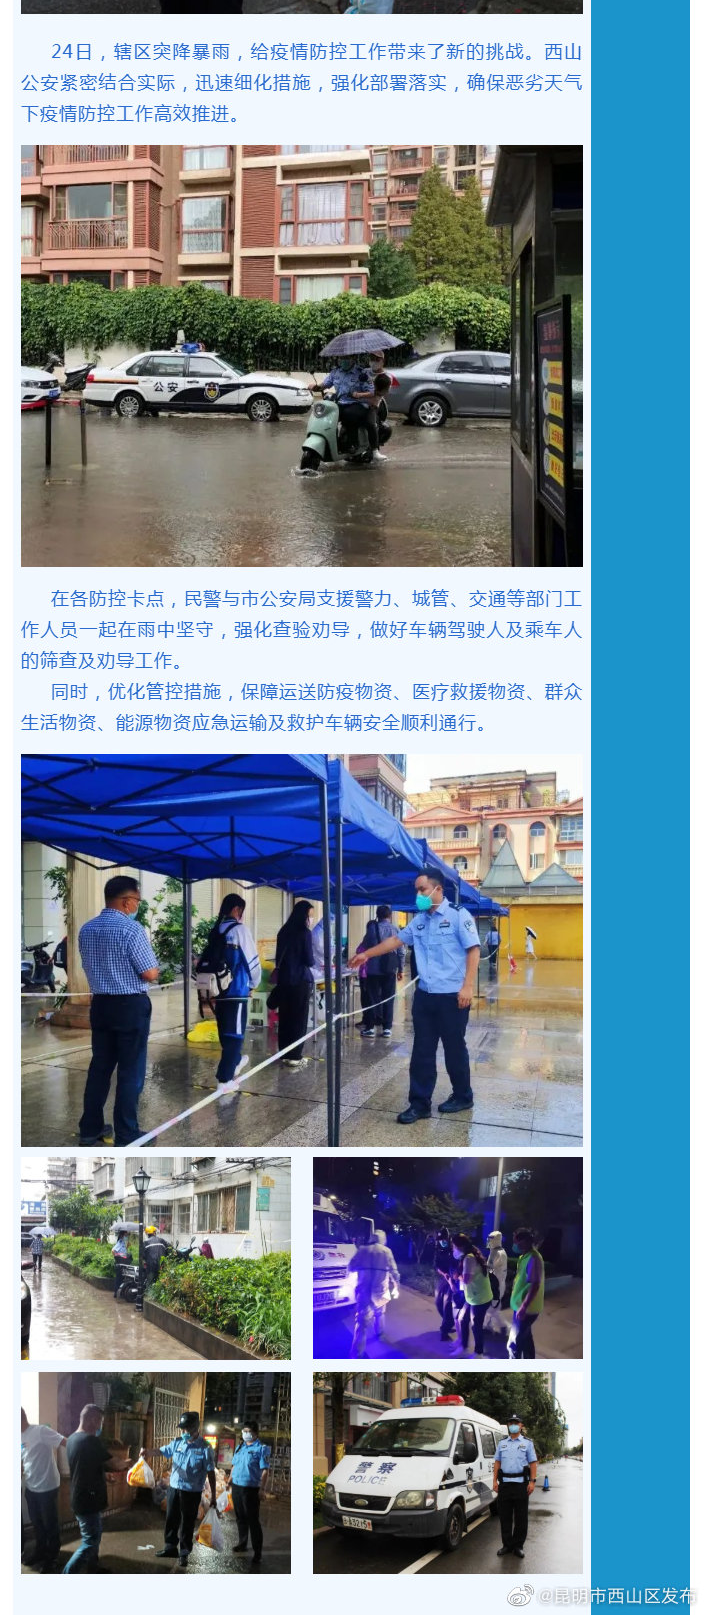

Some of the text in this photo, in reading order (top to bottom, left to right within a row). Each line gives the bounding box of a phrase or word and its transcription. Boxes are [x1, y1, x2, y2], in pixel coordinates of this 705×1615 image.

[21, 104, 236, 122] 下疫情防控工作高效推进。
[154, 382, 178, 393] 公安
[22, 651, 179, 669] 的筛查及劝导工作。
[354, 1461, 397, 1474] 警察
[347, 1475, 387, 1485] POLICE
